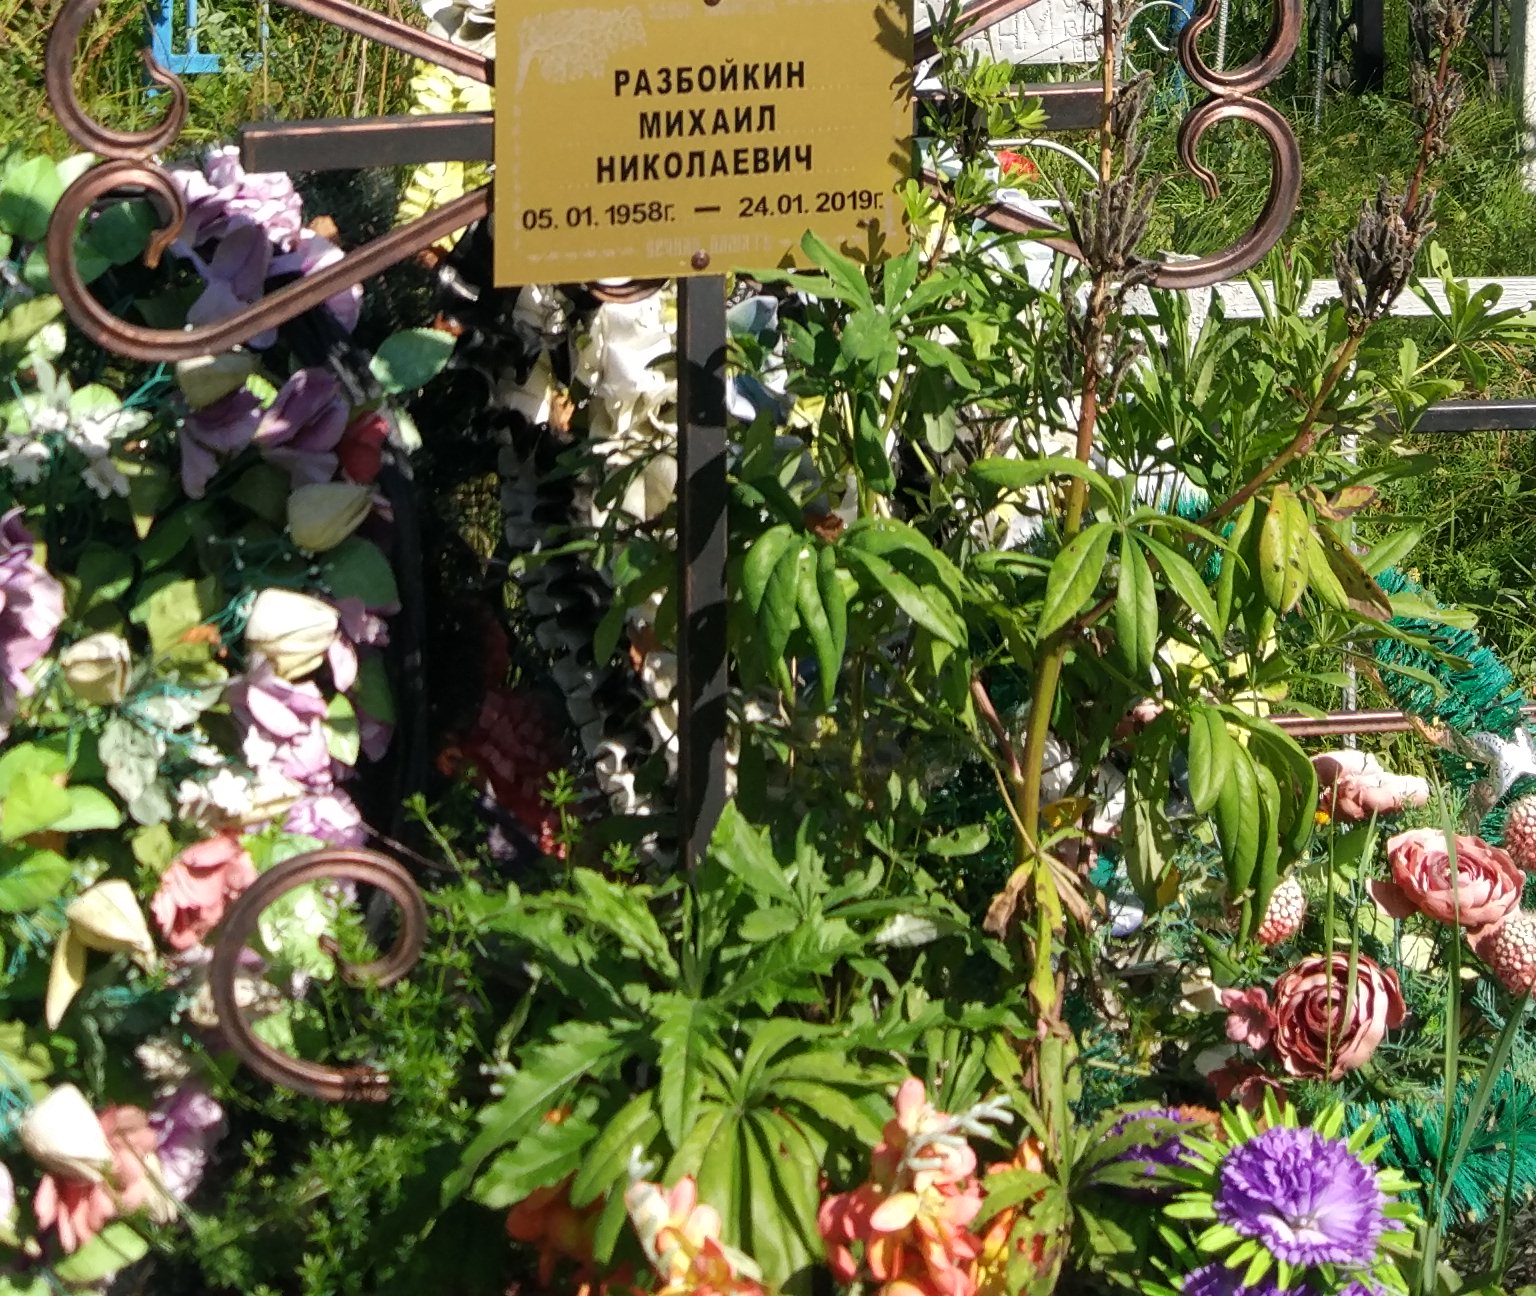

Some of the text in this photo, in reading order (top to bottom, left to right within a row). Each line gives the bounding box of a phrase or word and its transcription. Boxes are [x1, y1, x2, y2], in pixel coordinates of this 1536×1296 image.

[614, 58, 805, 97] РАЗБОЙКИН
[639, 104, 776, 140] МИХАИЛ
[596, 144, 813, 184] НИКОЛАЕВИЧ
